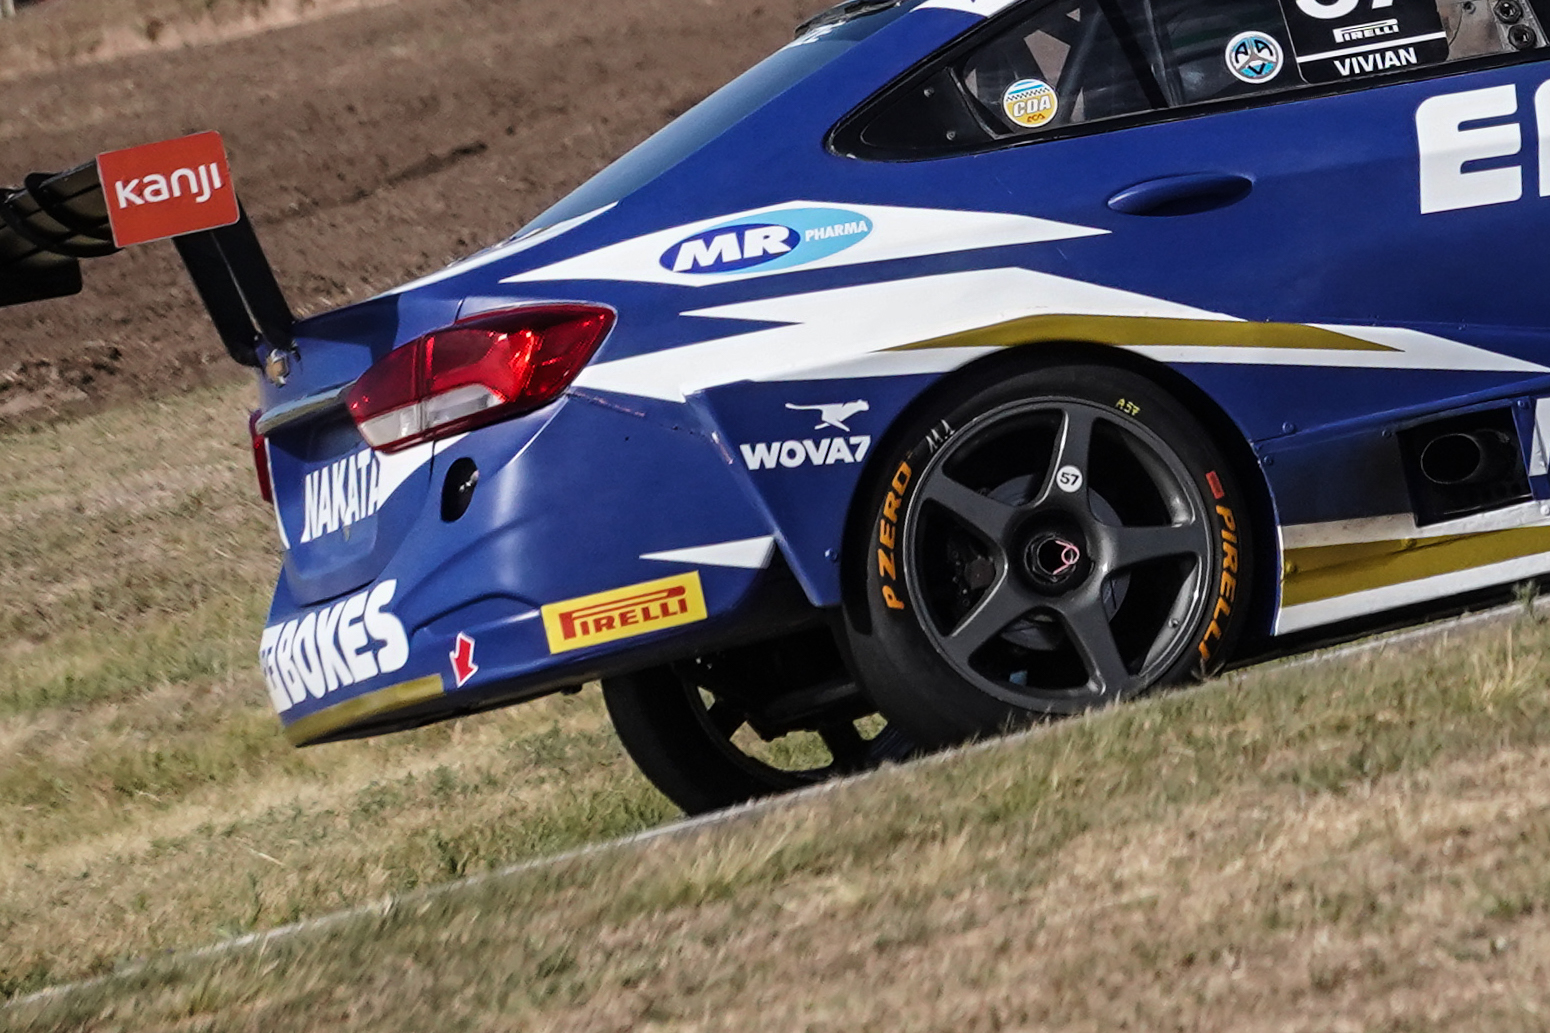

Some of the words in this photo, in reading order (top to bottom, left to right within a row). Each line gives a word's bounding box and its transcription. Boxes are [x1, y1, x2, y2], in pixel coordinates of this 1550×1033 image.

[1333, 19, 1399, 43] PIRELLI
[1334, 47, 1417, 76] VIVIAN
[1013, 95, 1052, 117] CDA
[115, 162, 222, 209] kanji
[673, 226, 792, 272] MR
[805, 221, 868, 242] PHARMA
[740, 435, 871, 470] WOVA7
[300, 447, 381, 544] NAKATA
[1060, 472, 1080, 486] 57
[877, 460, 912, 581] ZERO
[881, 585, 905, 610] P
[1198, 505, 1238, 659] PIRELLI
[559, 585, 688, 641] PIRELLI
